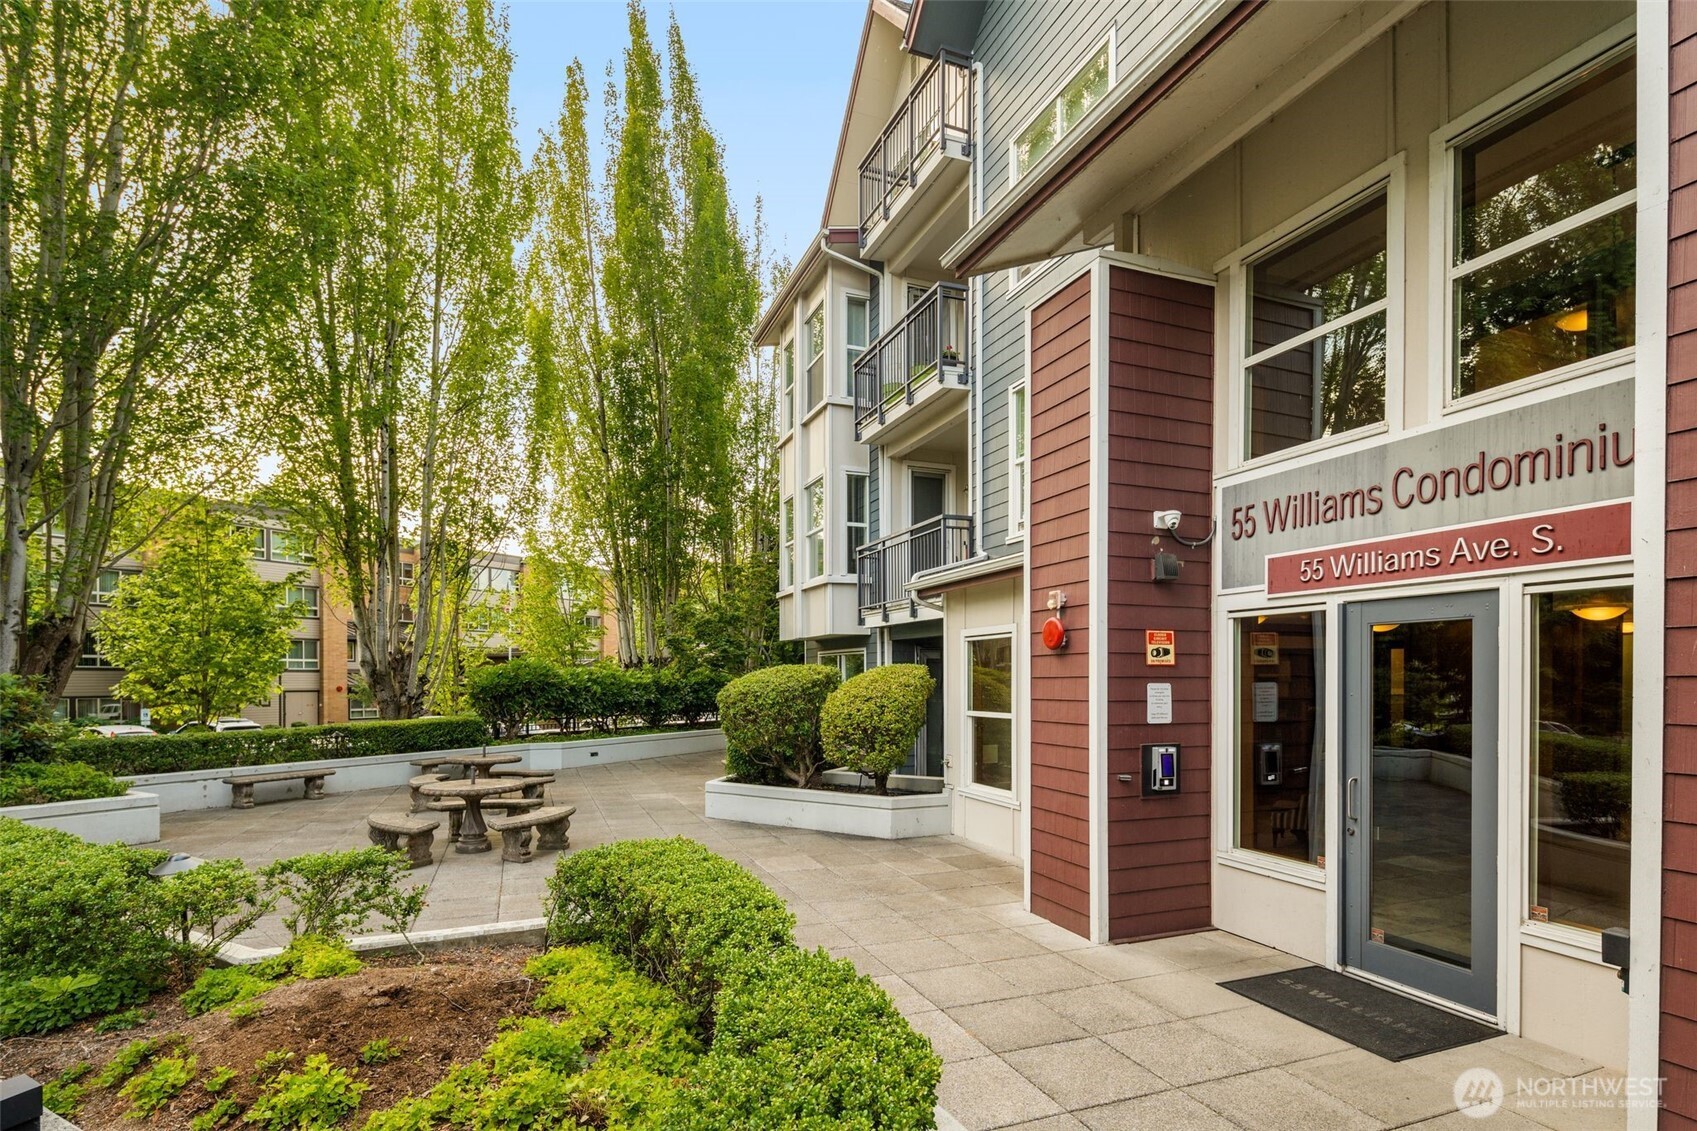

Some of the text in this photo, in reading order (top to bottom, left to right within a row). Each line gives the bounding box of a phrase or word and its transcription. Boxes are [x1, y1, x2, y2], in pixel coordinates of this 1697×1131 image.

[1231, 503, 1256, 540] 55
[1263, 484, 1383, 534] Williams
[1300, 524, 1564, 582] 55 Williams Ave. S.
